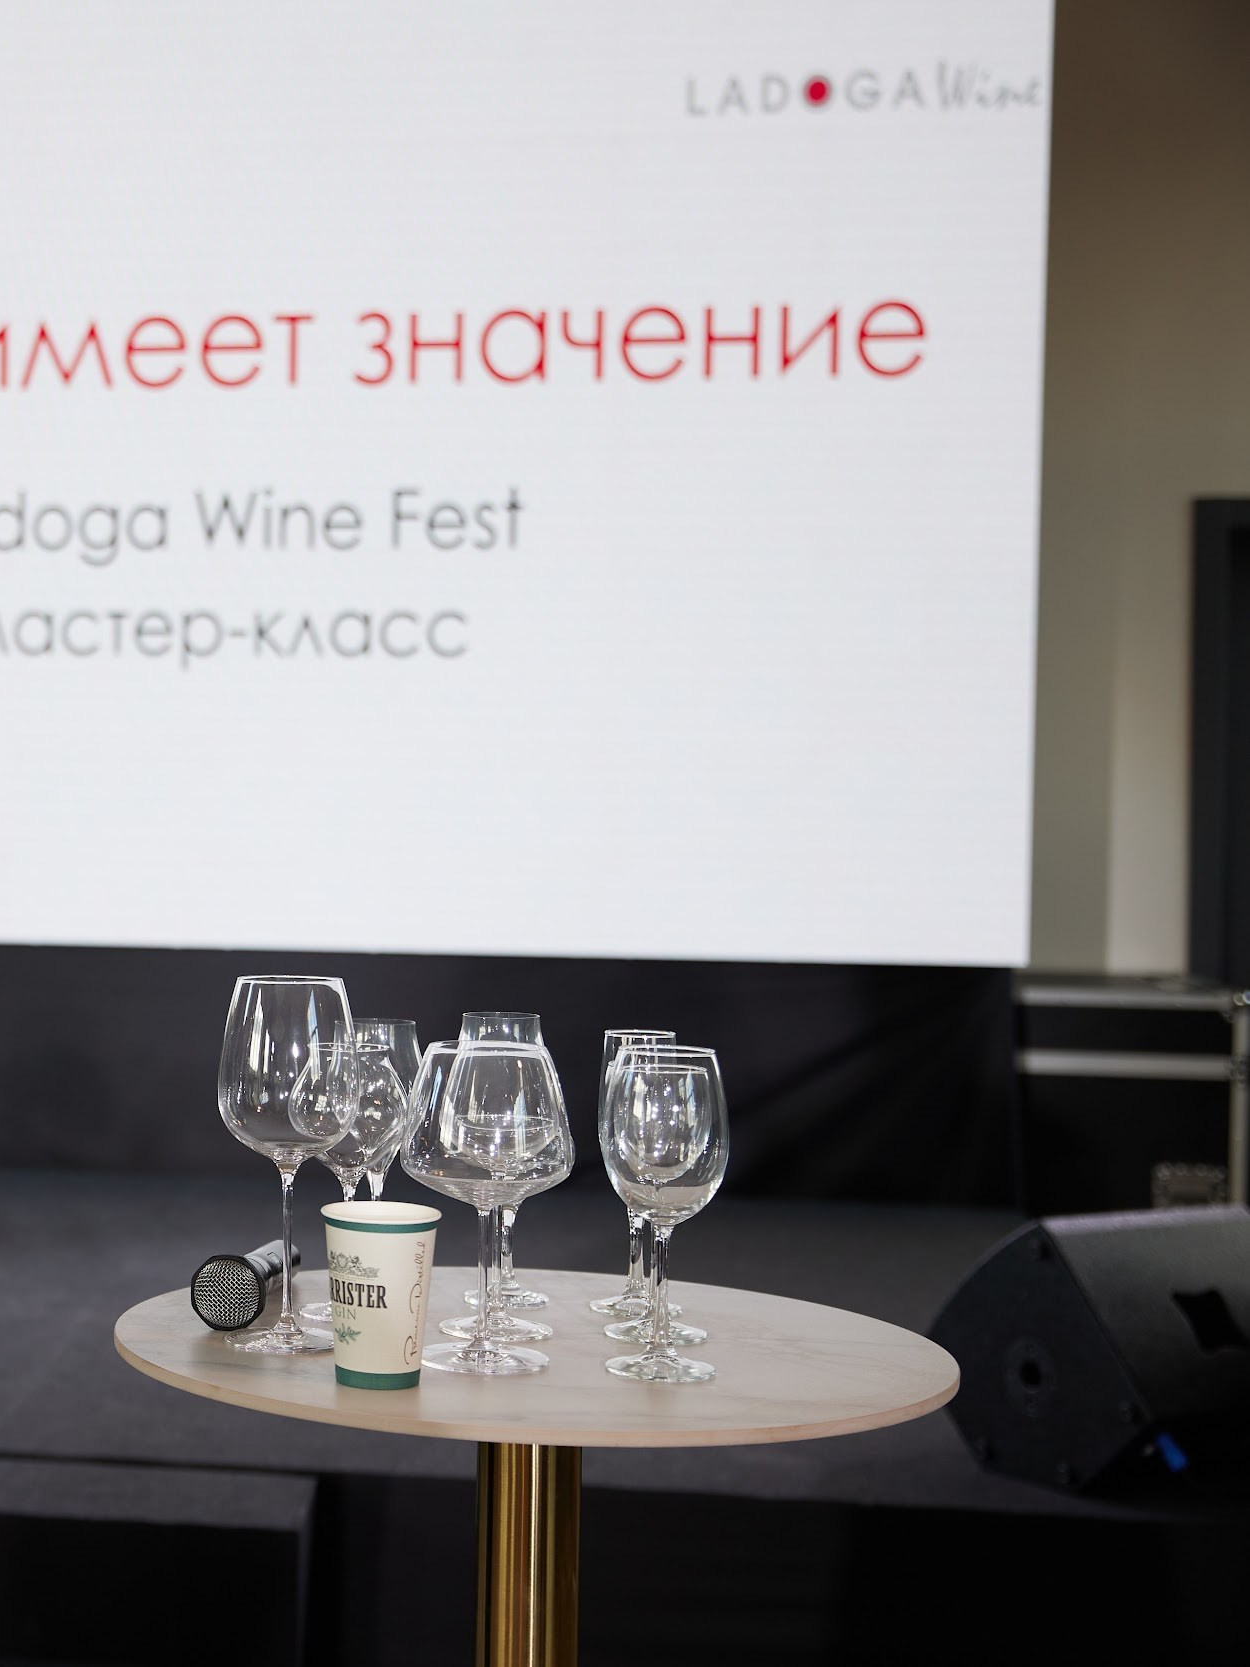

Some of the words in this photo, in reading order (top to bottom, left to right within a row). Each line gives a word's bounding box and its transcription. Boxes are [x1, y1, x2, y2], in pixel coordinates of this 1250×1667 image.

[687, 70, 924, 116] LADOGA
[353, 298, 928, 388] значение
[195, 489, 363, 551] Wine
[391, 487, 523, 550] Fest
[330, 1277, 387, 1309] RRISTER
[334, 1304, 356, 1320] GIN
